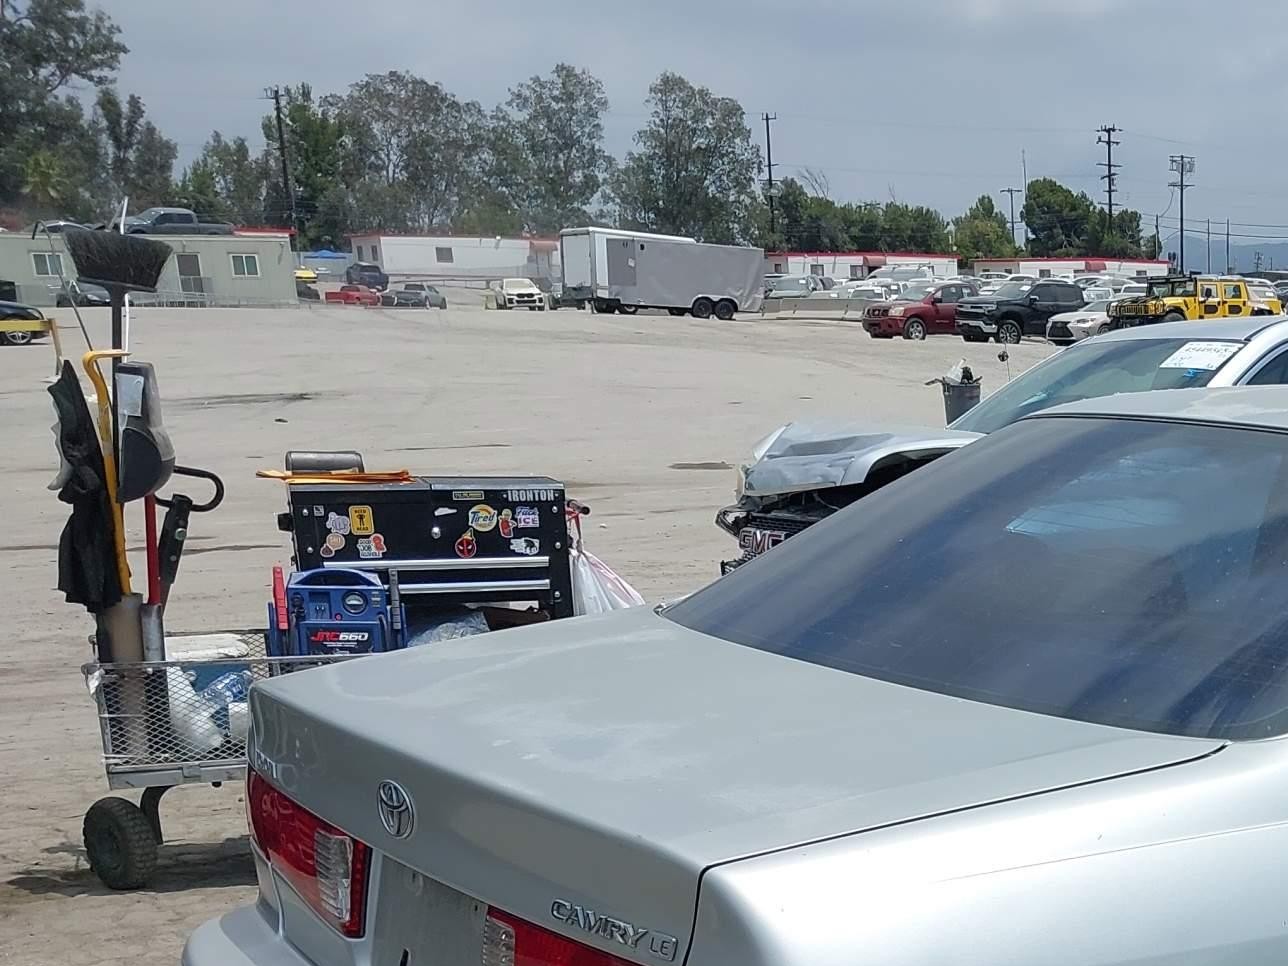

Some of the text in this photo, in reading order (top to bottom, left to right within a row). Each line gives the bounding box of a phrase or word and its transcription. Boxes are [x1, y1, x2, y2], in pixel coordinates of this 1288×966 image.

[508, 490, 554, 501] IRONTON
[470, 511, 496, 524] Tired
[551, 899, 671, 956] CAMRY LE
